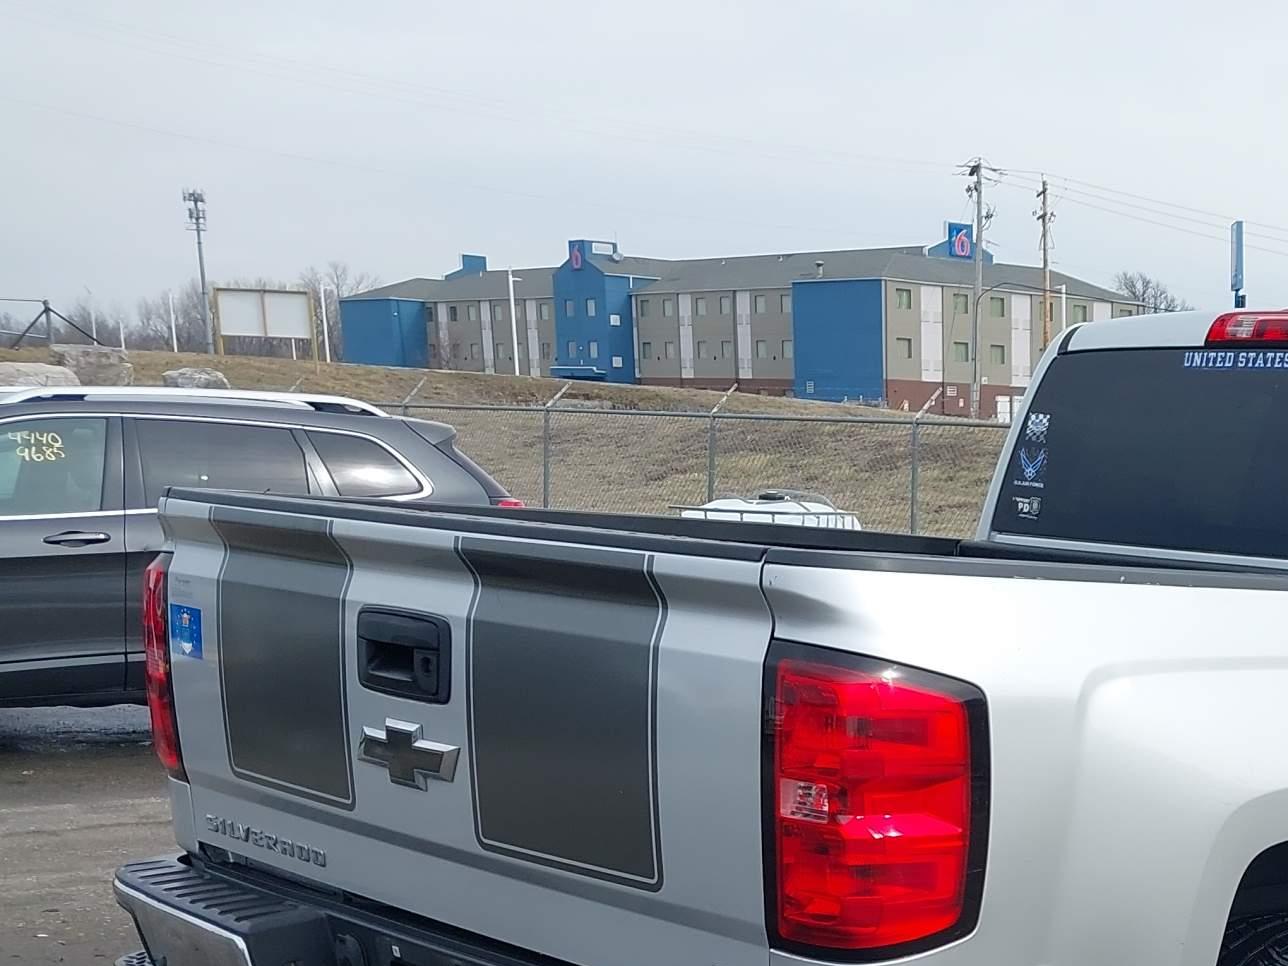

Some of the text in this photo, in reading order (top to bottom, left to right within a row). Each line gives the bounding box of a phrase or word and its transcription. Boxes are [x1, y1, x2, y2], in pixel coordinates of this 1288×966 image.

[1184, 352, 1235, 368] UNITED
[16, 446, 65, 461] 9685
[1018, 502, 1030, 513] PD
[205, 813, 327, 868] SILVERADO
